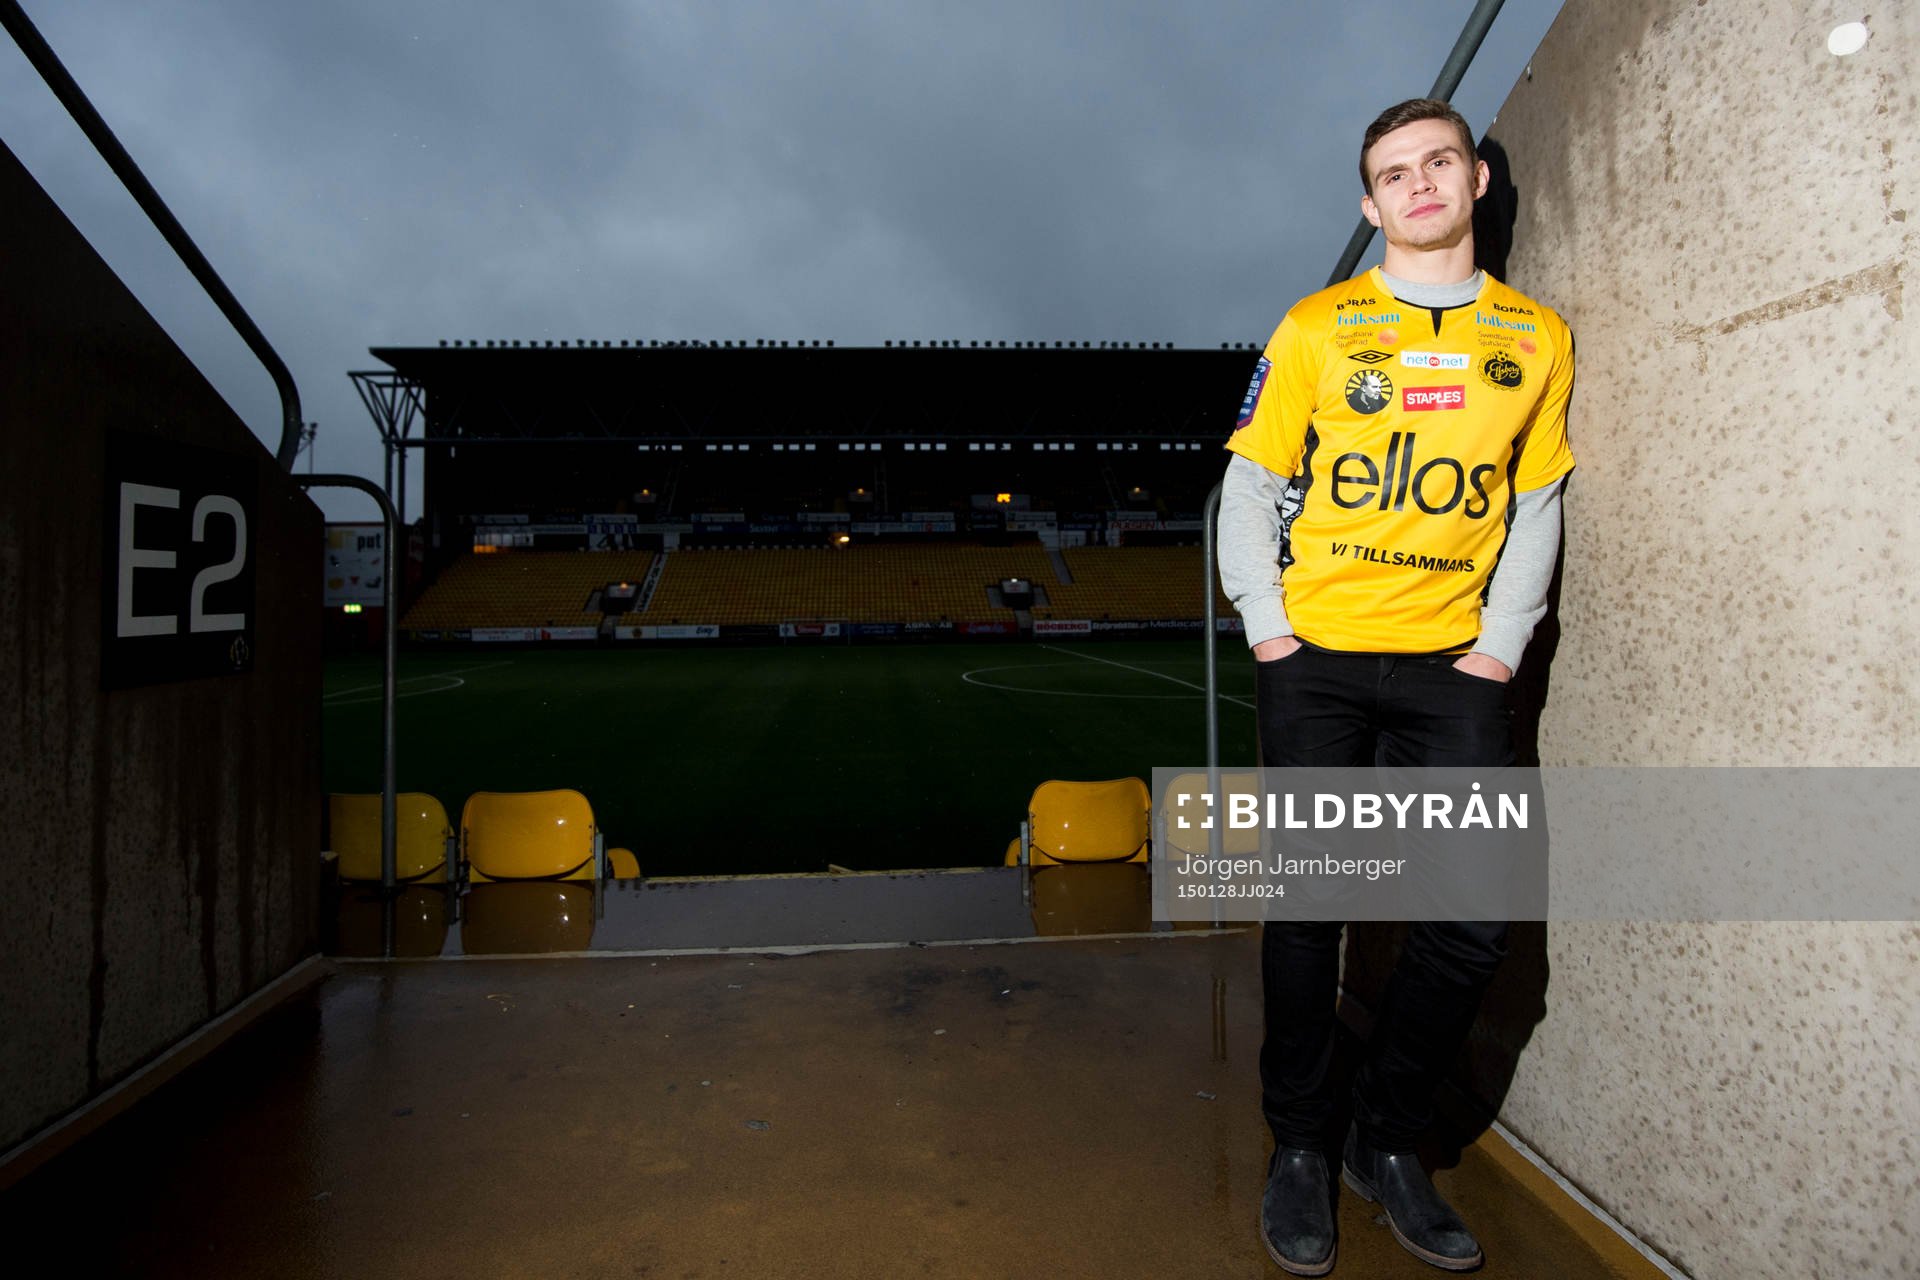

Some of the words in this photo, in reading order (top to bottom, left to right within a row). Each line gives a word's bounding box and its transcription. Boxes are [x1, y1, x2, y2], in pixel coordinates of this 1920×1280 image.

[1337, 312, 1400, 325] Folksam
[1477, 311, 1536, 332] Folksam
[1406, 391, 1462, 405] STAPLES
[1331, 431, 1497, 520] ellos
[117, 481, 247, 638] E2
[1331, 542, 1348, 557] VI
[1353, 545, 1476, 573] TILLSAMMANS
